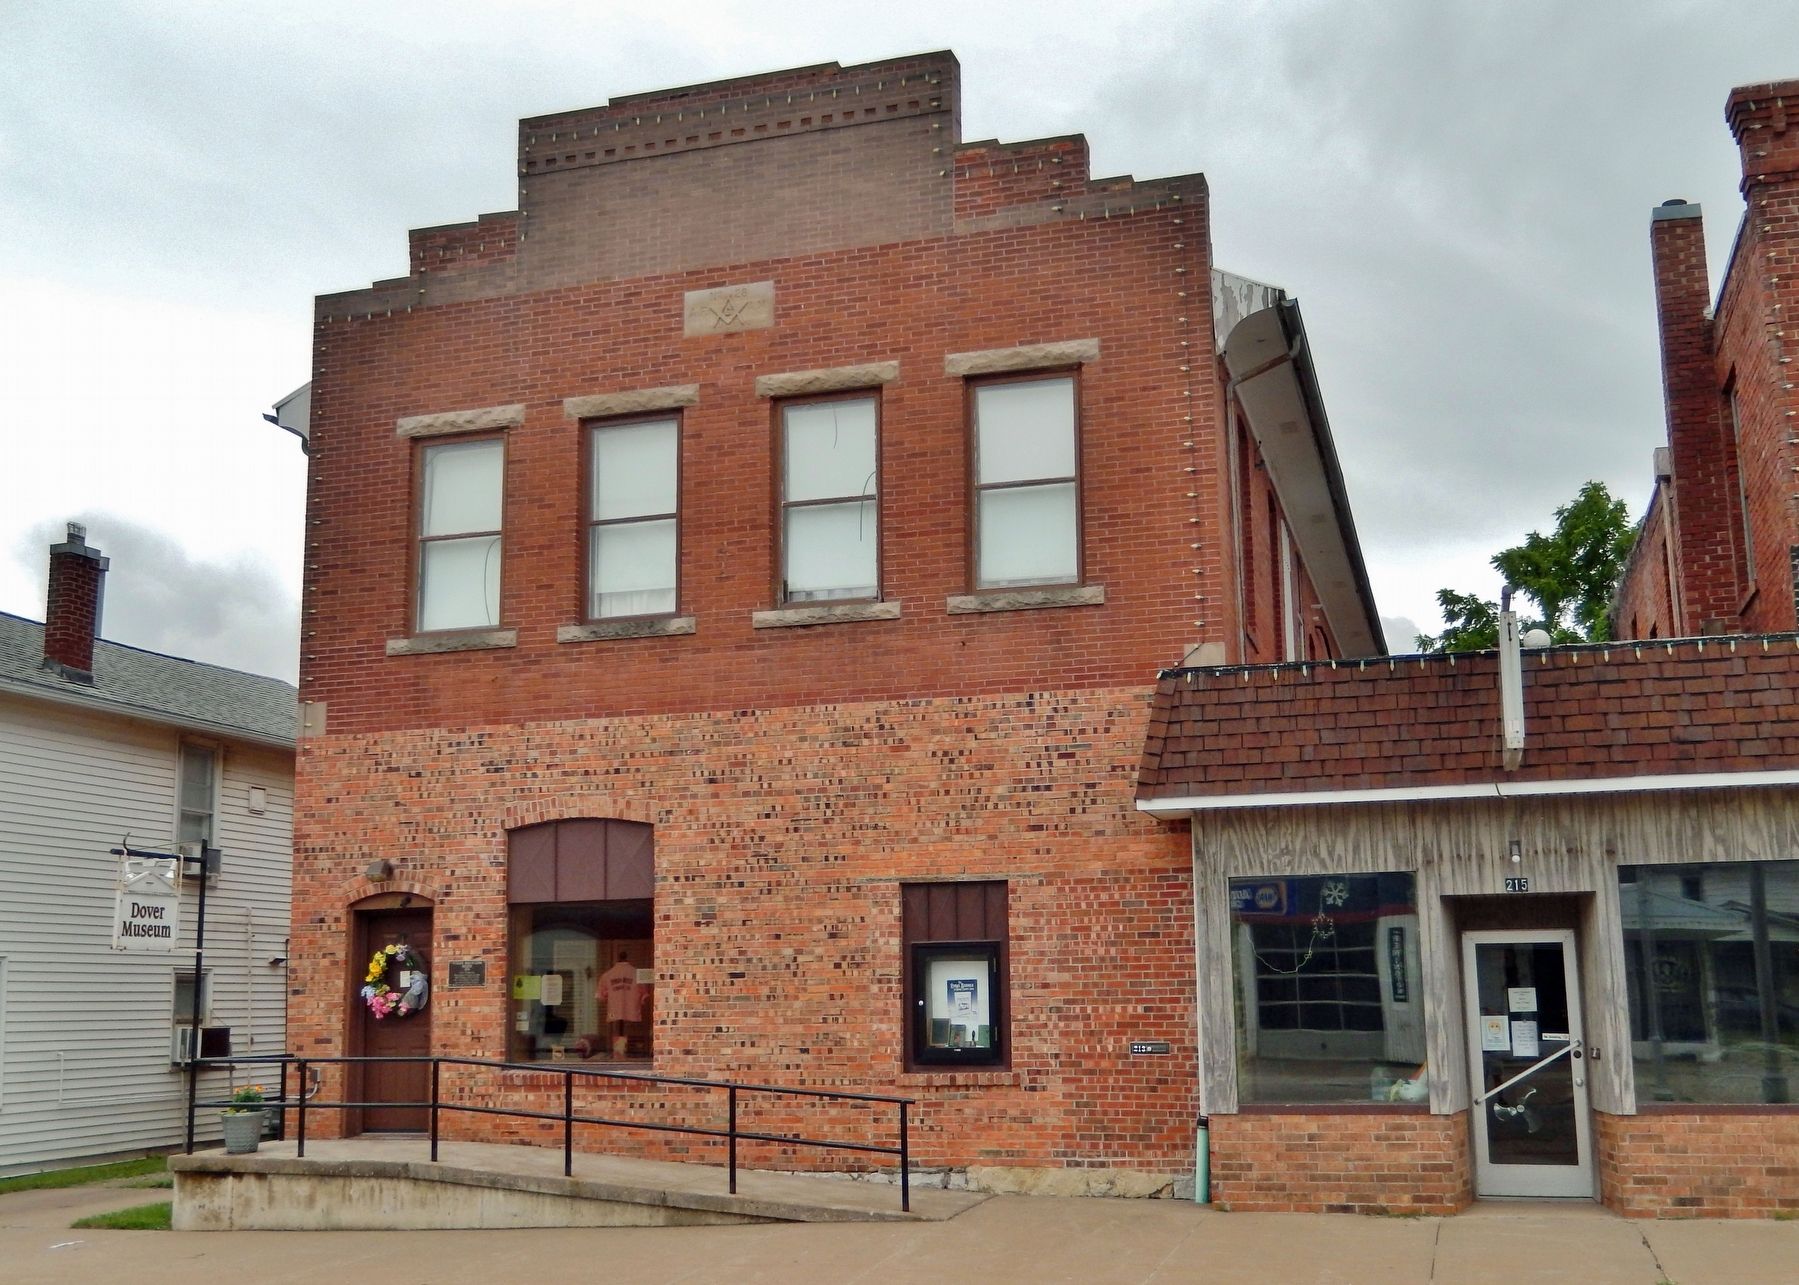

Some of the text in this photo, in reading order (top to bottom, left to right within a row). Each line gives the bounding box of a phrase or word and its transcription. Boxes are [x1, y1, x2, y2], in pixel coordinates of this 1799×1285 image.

[1506, 879, 1528, 891] 215
[131, 902, 165, 919] Dover
[121, 920, 171, 938] Museum
